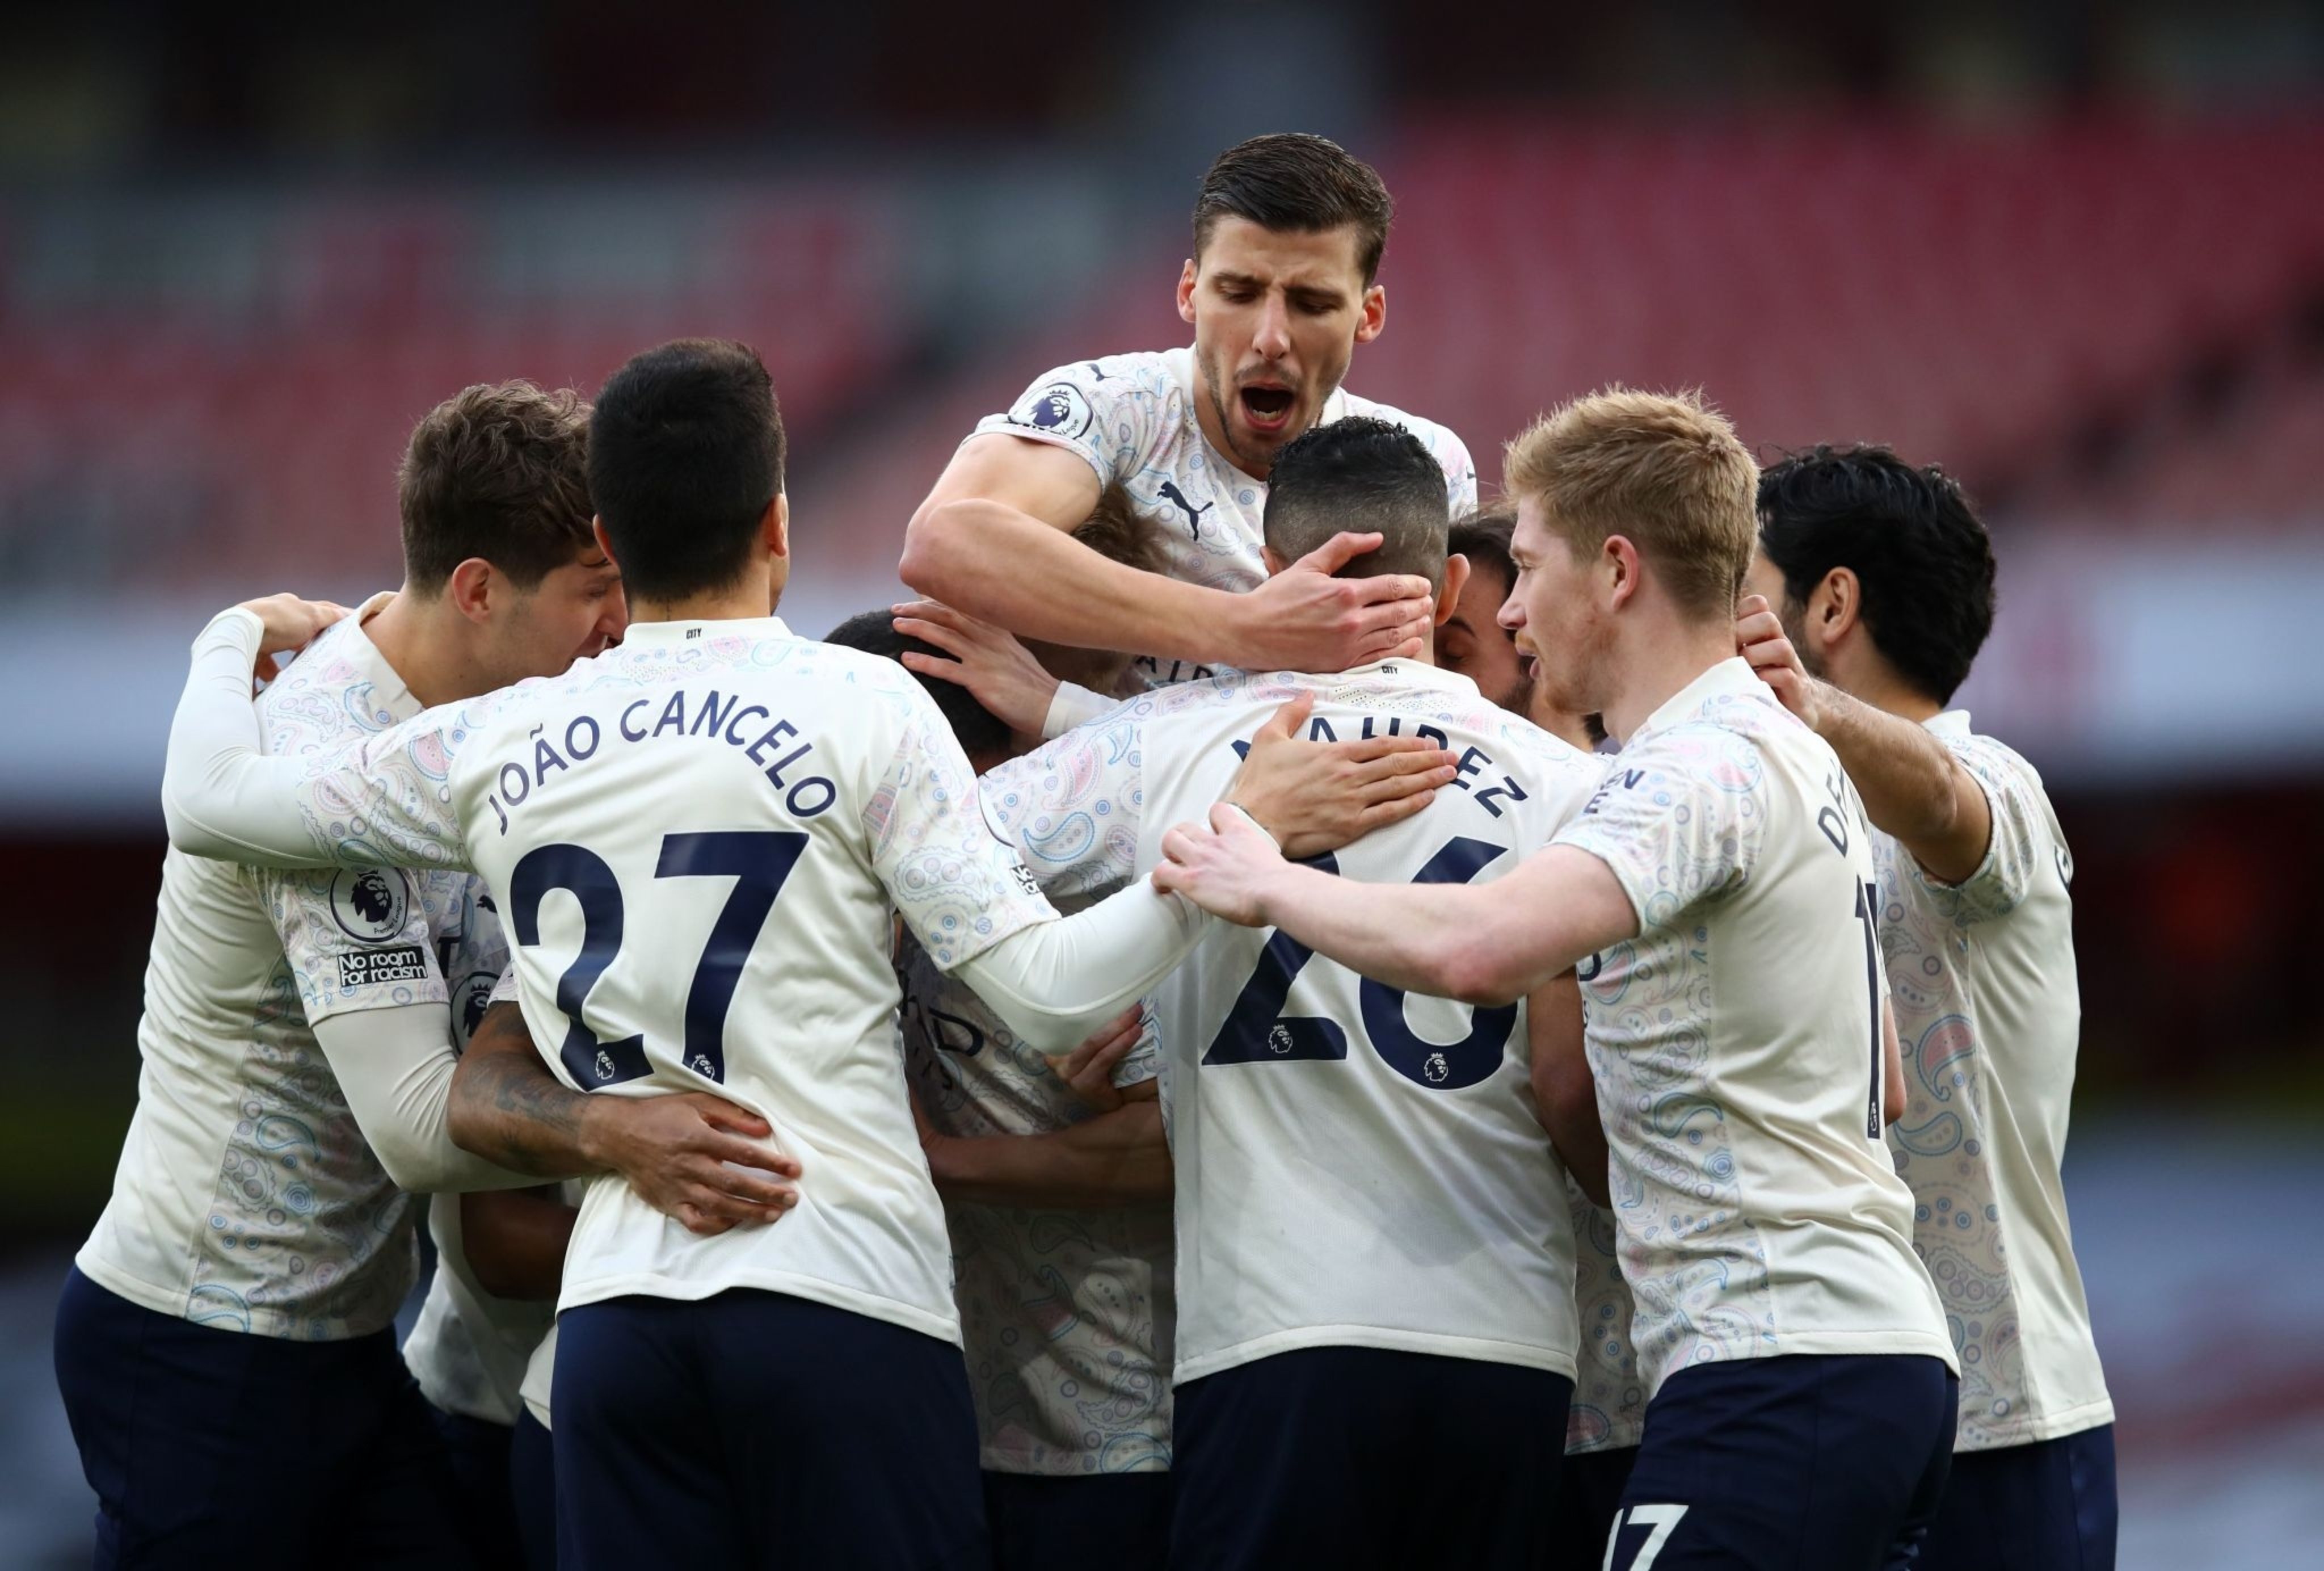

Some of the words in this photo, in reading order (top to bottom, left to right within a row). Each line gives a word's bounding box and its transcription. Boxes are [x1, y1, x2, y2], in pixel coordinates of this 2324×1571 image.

[686, 627, 702, 640] CITY
[1382, 666, 1397, 674] CITY
[489, 715, 600, 836] JOÃO
[620, 690, 836, 817] CANCELO
[338, 953, 367, 972] No
[369, 951, 417, 967] room
[509, 831, 810, 1093] 27
[341, 969, 367, 986] for
[371, 965, 427, 982] racism
